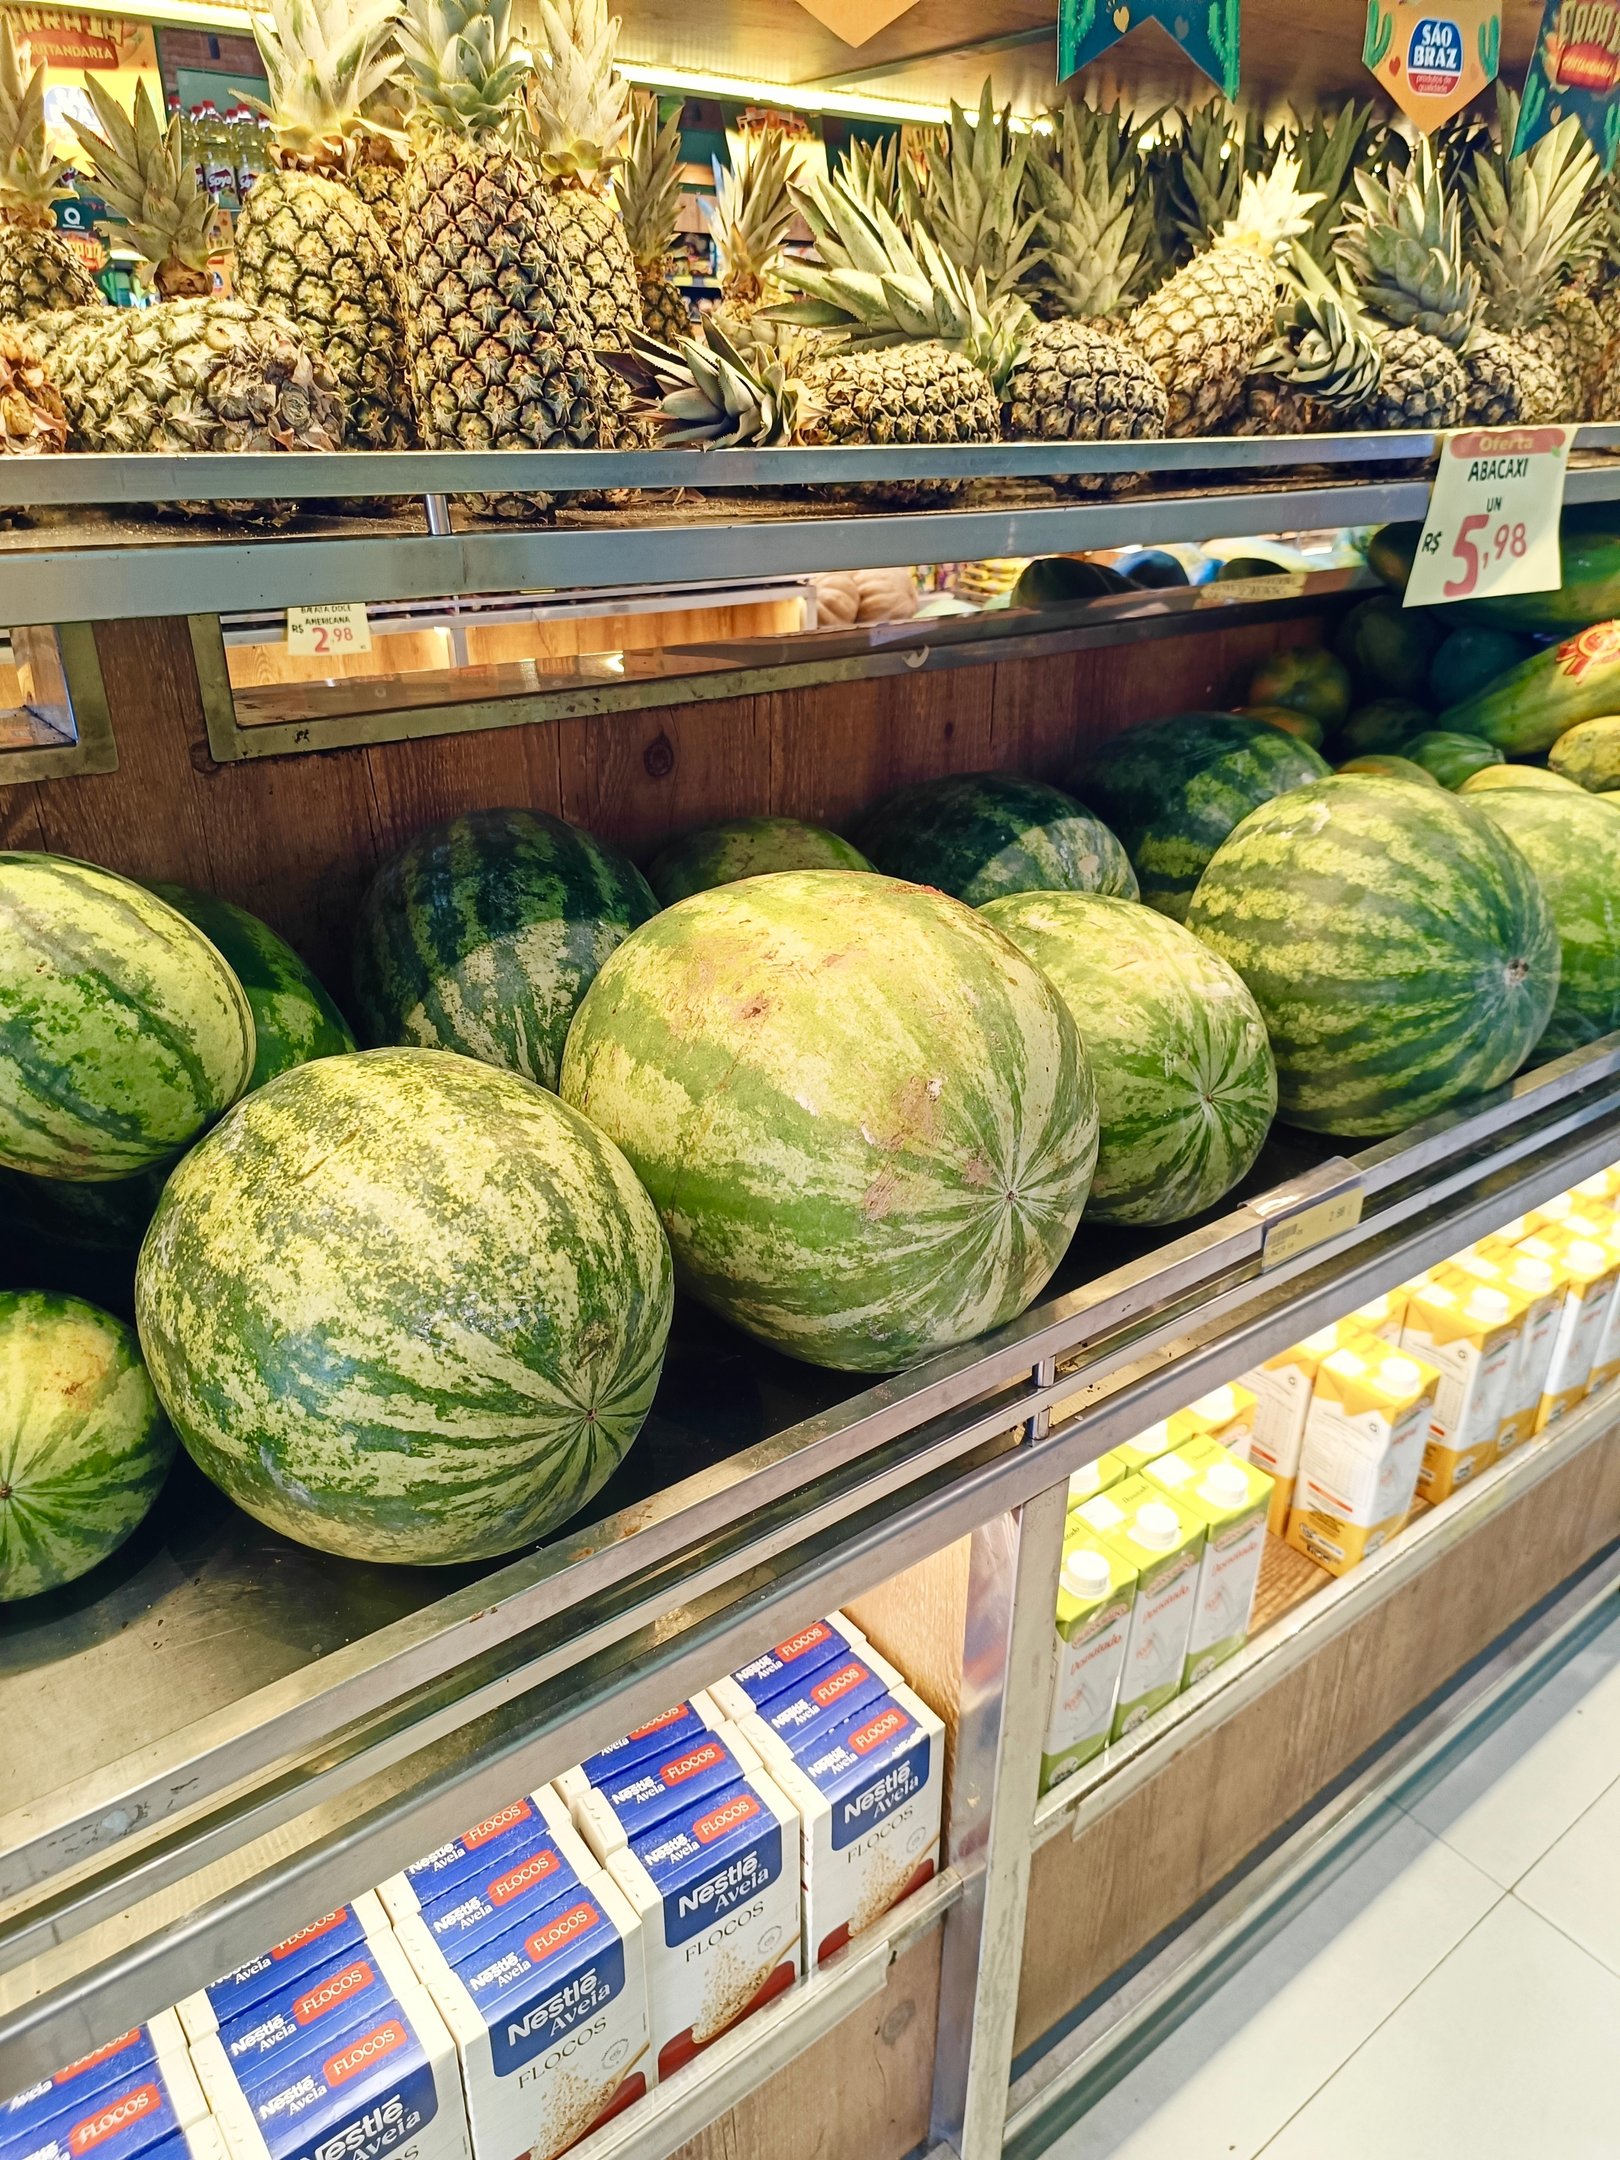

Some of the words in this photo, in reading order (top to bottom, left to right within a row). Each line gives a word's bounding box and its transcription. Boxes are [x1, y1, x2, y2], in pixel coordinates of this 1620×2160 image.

[1413, 45, 1458, 69] BRAZ
[208, 175, 232, 188] Soya
[1478, 434, 1534, 452] Oferta
[1468, 457, 1530, 482] ABACAXI
[1486, 497, 1503, 513] UN
[1421, 530, 1443, 555] R$
[1442, 513, 1528, 598] 5,98
[291, 624, 304, 634] R$
[311, 627, 353, 653] 2,98
[305, 616, 351, 626] AMERICANA
[782, 1627, 823, 1656] FLOCOS
[818, 1669, 860, 1700] FLOCOS
[855, 1713, 899, 1748] FLOCOS
[667, 1748, 716, 1779] FLOCOS
[637, 1783, 666, 1804] Aveia
[844, 1759, 911, 1824] Nestlé
[873, 1775, 919, 1819] Aveia
[469, 1805, 521, 1841] FLOCOS
[701, 1800, 750, 1836] FLOCOS
[847, 1804, 913, 1864] FLOCOS
[433, 1847, 466, 1872] Aveia
[670, 1840, 701, 1864] Aveia
[496, 1856, 549, 1897] FLOCOS
[678, 1850, 758, 1919] Nestlé
[714, 1867, 769, 1913] Aveia
[460, 1904, 493, 1930] Aveia
[533, 1910, 588, 1952] FLOCOS
[685, 1900, 764, 1963] FLOCOS
[235, 1957, 272, 1984] Aveia
[497, 1959, 532, 1988] Aveia
[301, 1969, 363, 2015] FLOCOS
[507, 1967, 598, 2047] Nestlé
[550, 1983, 611, 2037] Aveia
[230, 2014, 287, 2057] Nestlé
[259, 2022, 297, 2053] Aveia
[332, 2028, 395, 2075] FLOCOS
[518, 2016, 606, 2089] FLOCOS
[259, 2075, 317, 2120] Nestlé
[288, 2083, 328, 2116] Aveia
[79, 2091, 149, 2144] FLOCOS
